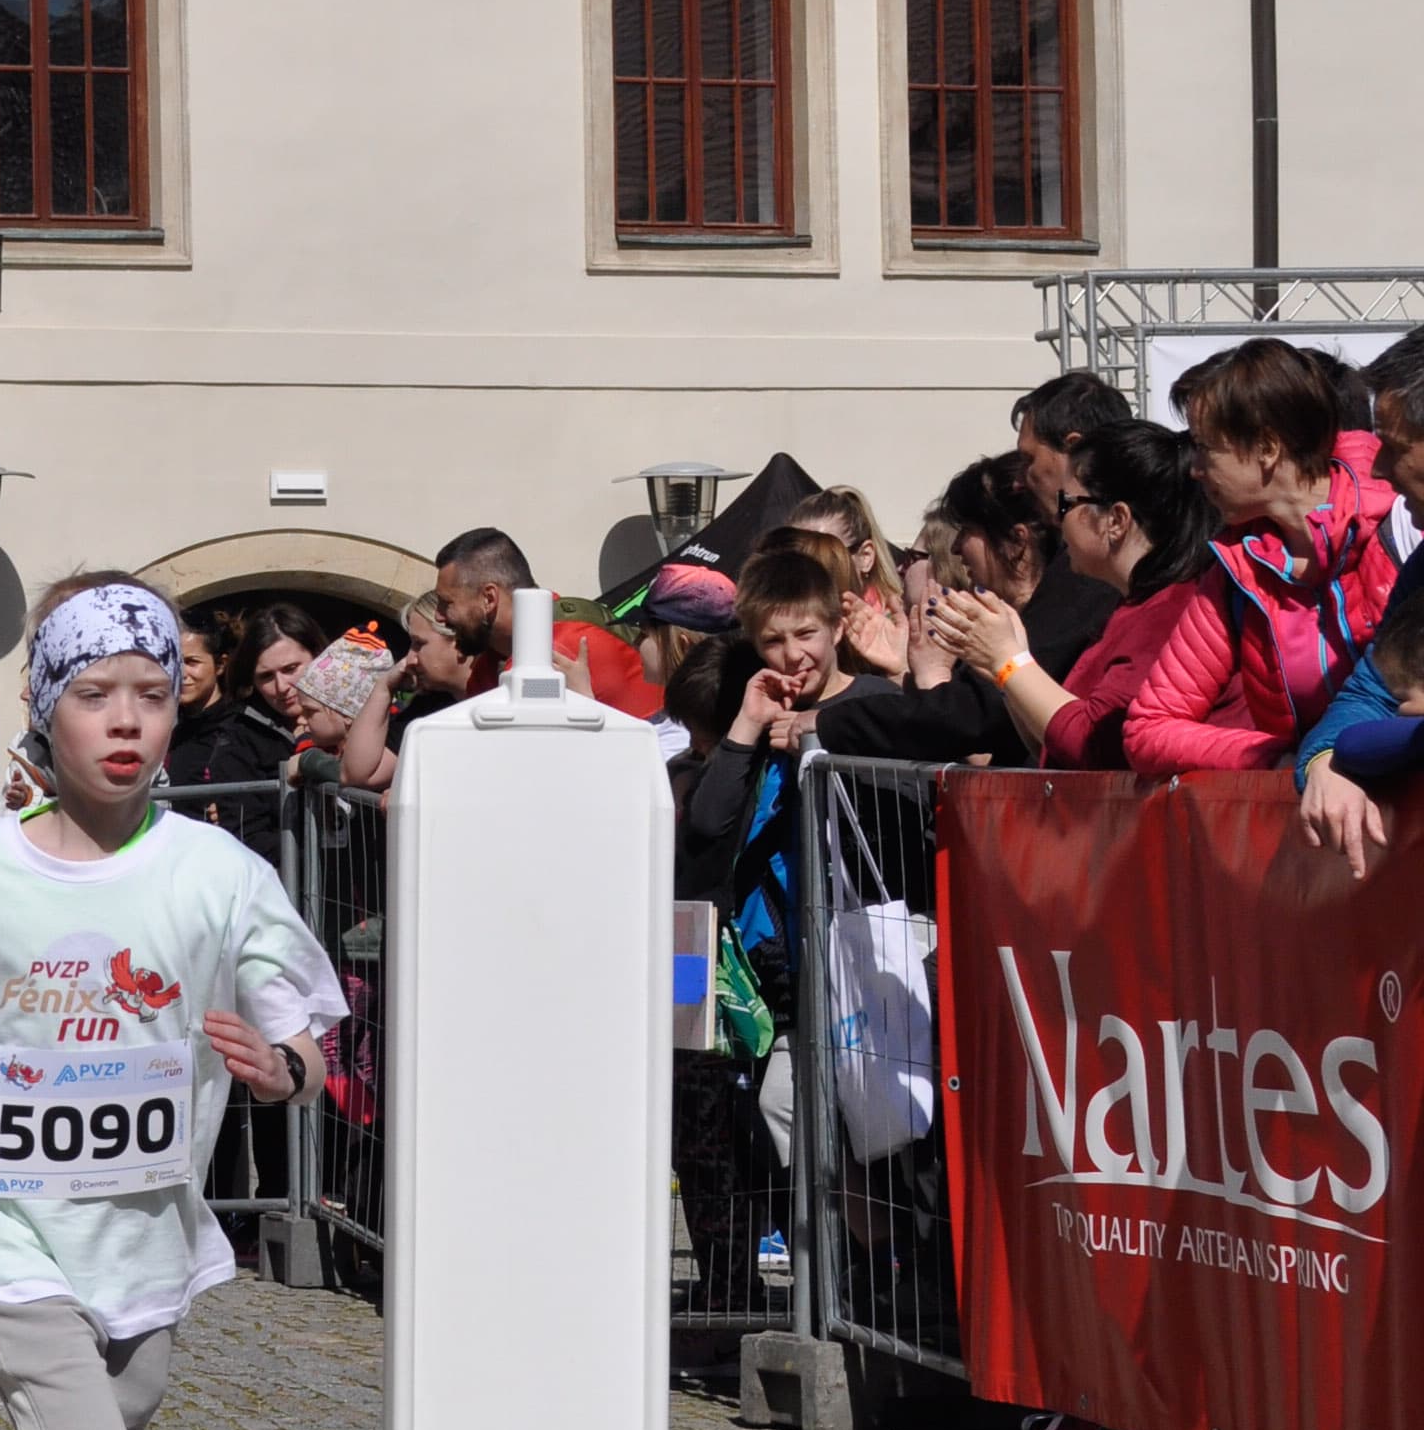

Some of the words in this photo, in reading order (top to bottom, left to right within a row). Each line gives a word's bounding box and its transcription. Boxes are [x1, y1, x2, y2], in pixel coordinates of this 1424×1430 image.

[29, 960, 90, 979] PVZP
[57, 1017, 120, 1042] run
[79, 1062, 126, 1077] PVZP
[163, 1067, 183, 1077] run
[998, 946, 1390, 1214] Nartes
[10, 1178, 44, 1190] PVZP
[1076, 1211, 1167, 1259] QUALITY
[1266, 1243, 1349, 1293] SPRING
